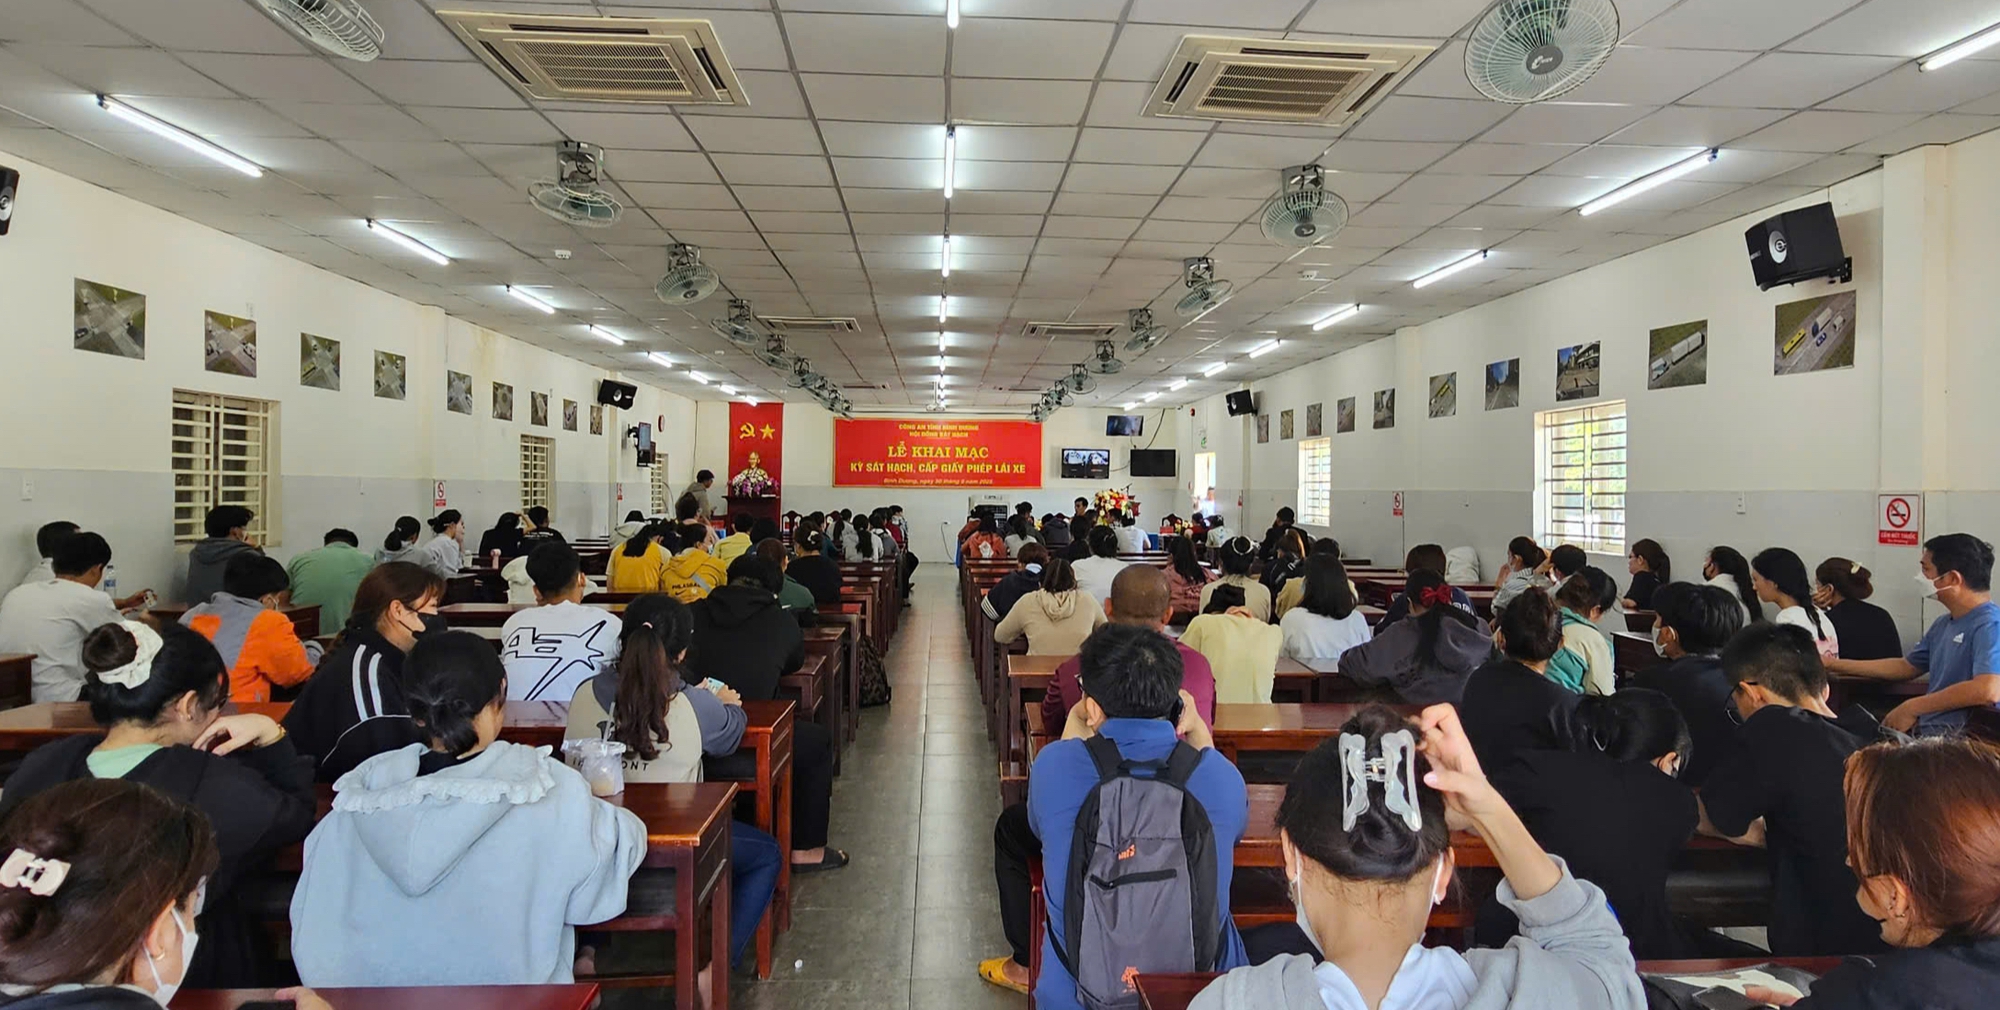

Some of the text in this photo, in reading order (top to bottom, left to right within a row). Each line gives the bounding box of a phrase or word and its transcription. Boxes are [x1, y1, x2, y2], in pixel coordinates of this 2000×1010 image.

[888, 440, 989, 461] LỄ KHAI MẠC
[866, 461, 885, 472] SÁT
[918, 460, 939, 473] CẤP
[941, 461, 964, 473] GIẤY
[967, 462, 993, 474] PHÉP
[995, 462, 1011, 474] LÁI
[1013, 464, 1026, 474] XE
